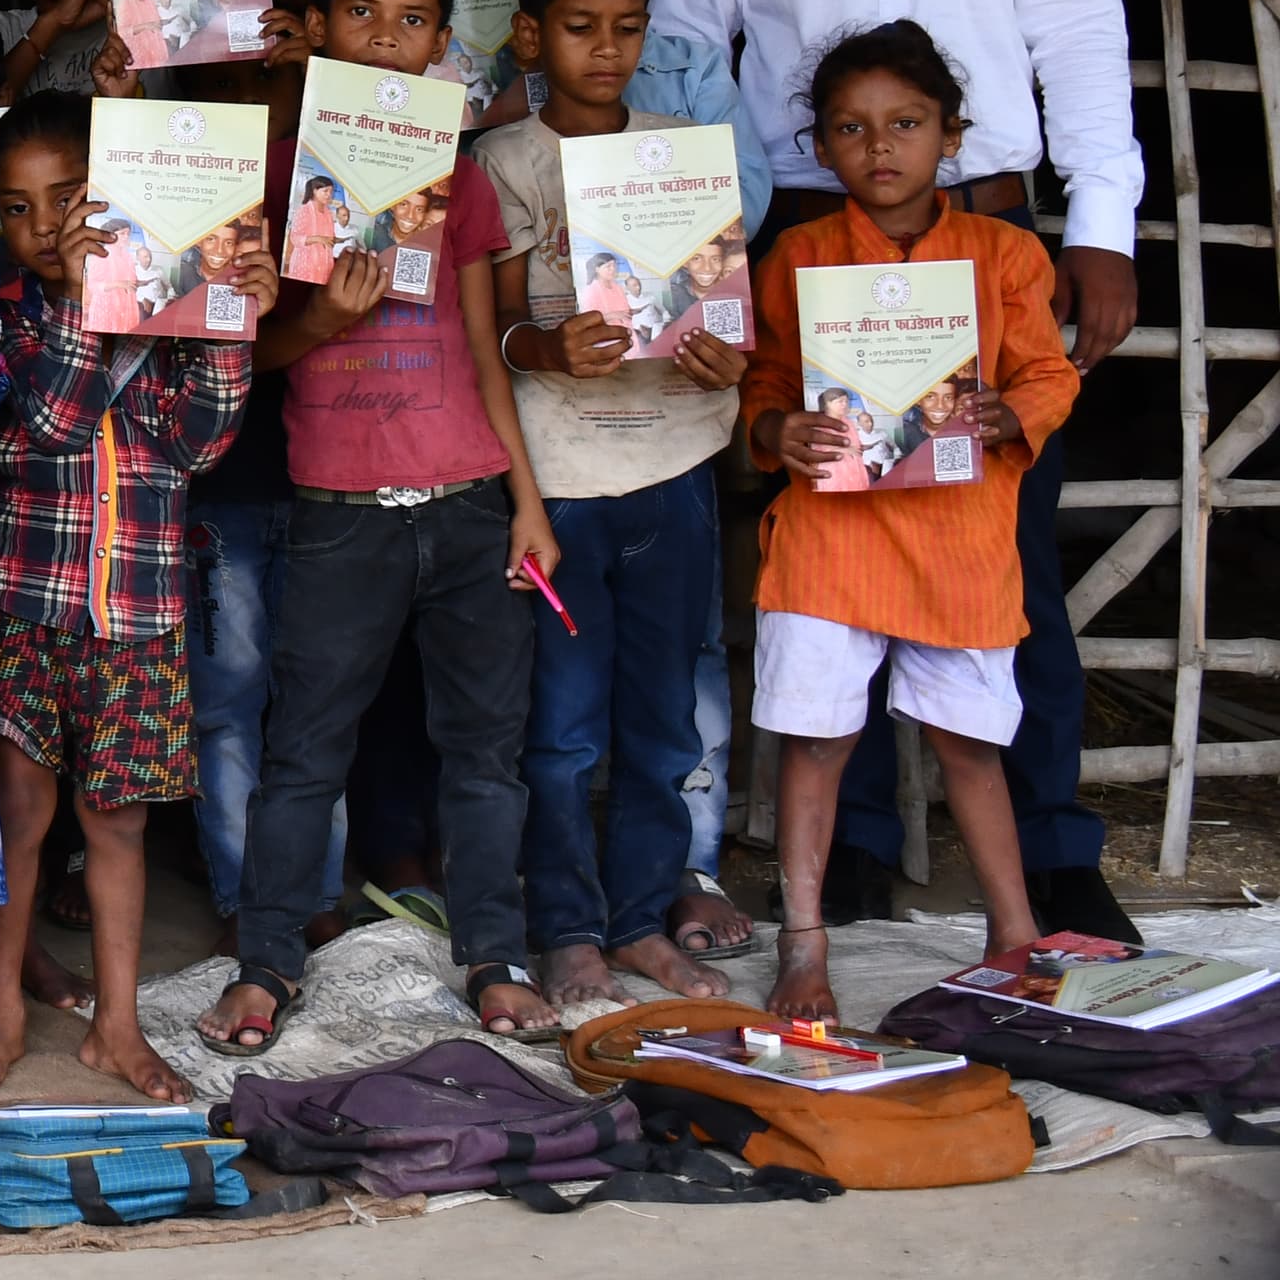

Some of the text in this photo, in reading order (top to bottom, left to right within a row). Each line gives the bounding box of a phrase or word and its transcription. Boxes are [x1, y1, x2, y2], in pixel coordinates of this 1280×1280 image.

[316, 109, 352, 127] आनन्द
[354, 113, 385, 133] जीवन
[387, 120, 432, 141] फाउंडेशन
[434, 130, 454, 145] ट्रस्ट
[106, 149, 259, 174] आनन्द जीवन फाउंडेशन ट्रस्ट
[579, 175, 732, 200] आनन्द जीवन फाउंडेशन ट्रस्ट
[813, 314, 969, 335] आनन्द जीवन फाउंडेशन ट्रस्ट
[343, 351, 390, 371] need
[396, 351, 435, 370] little
[331, 380, 419, 425] change
